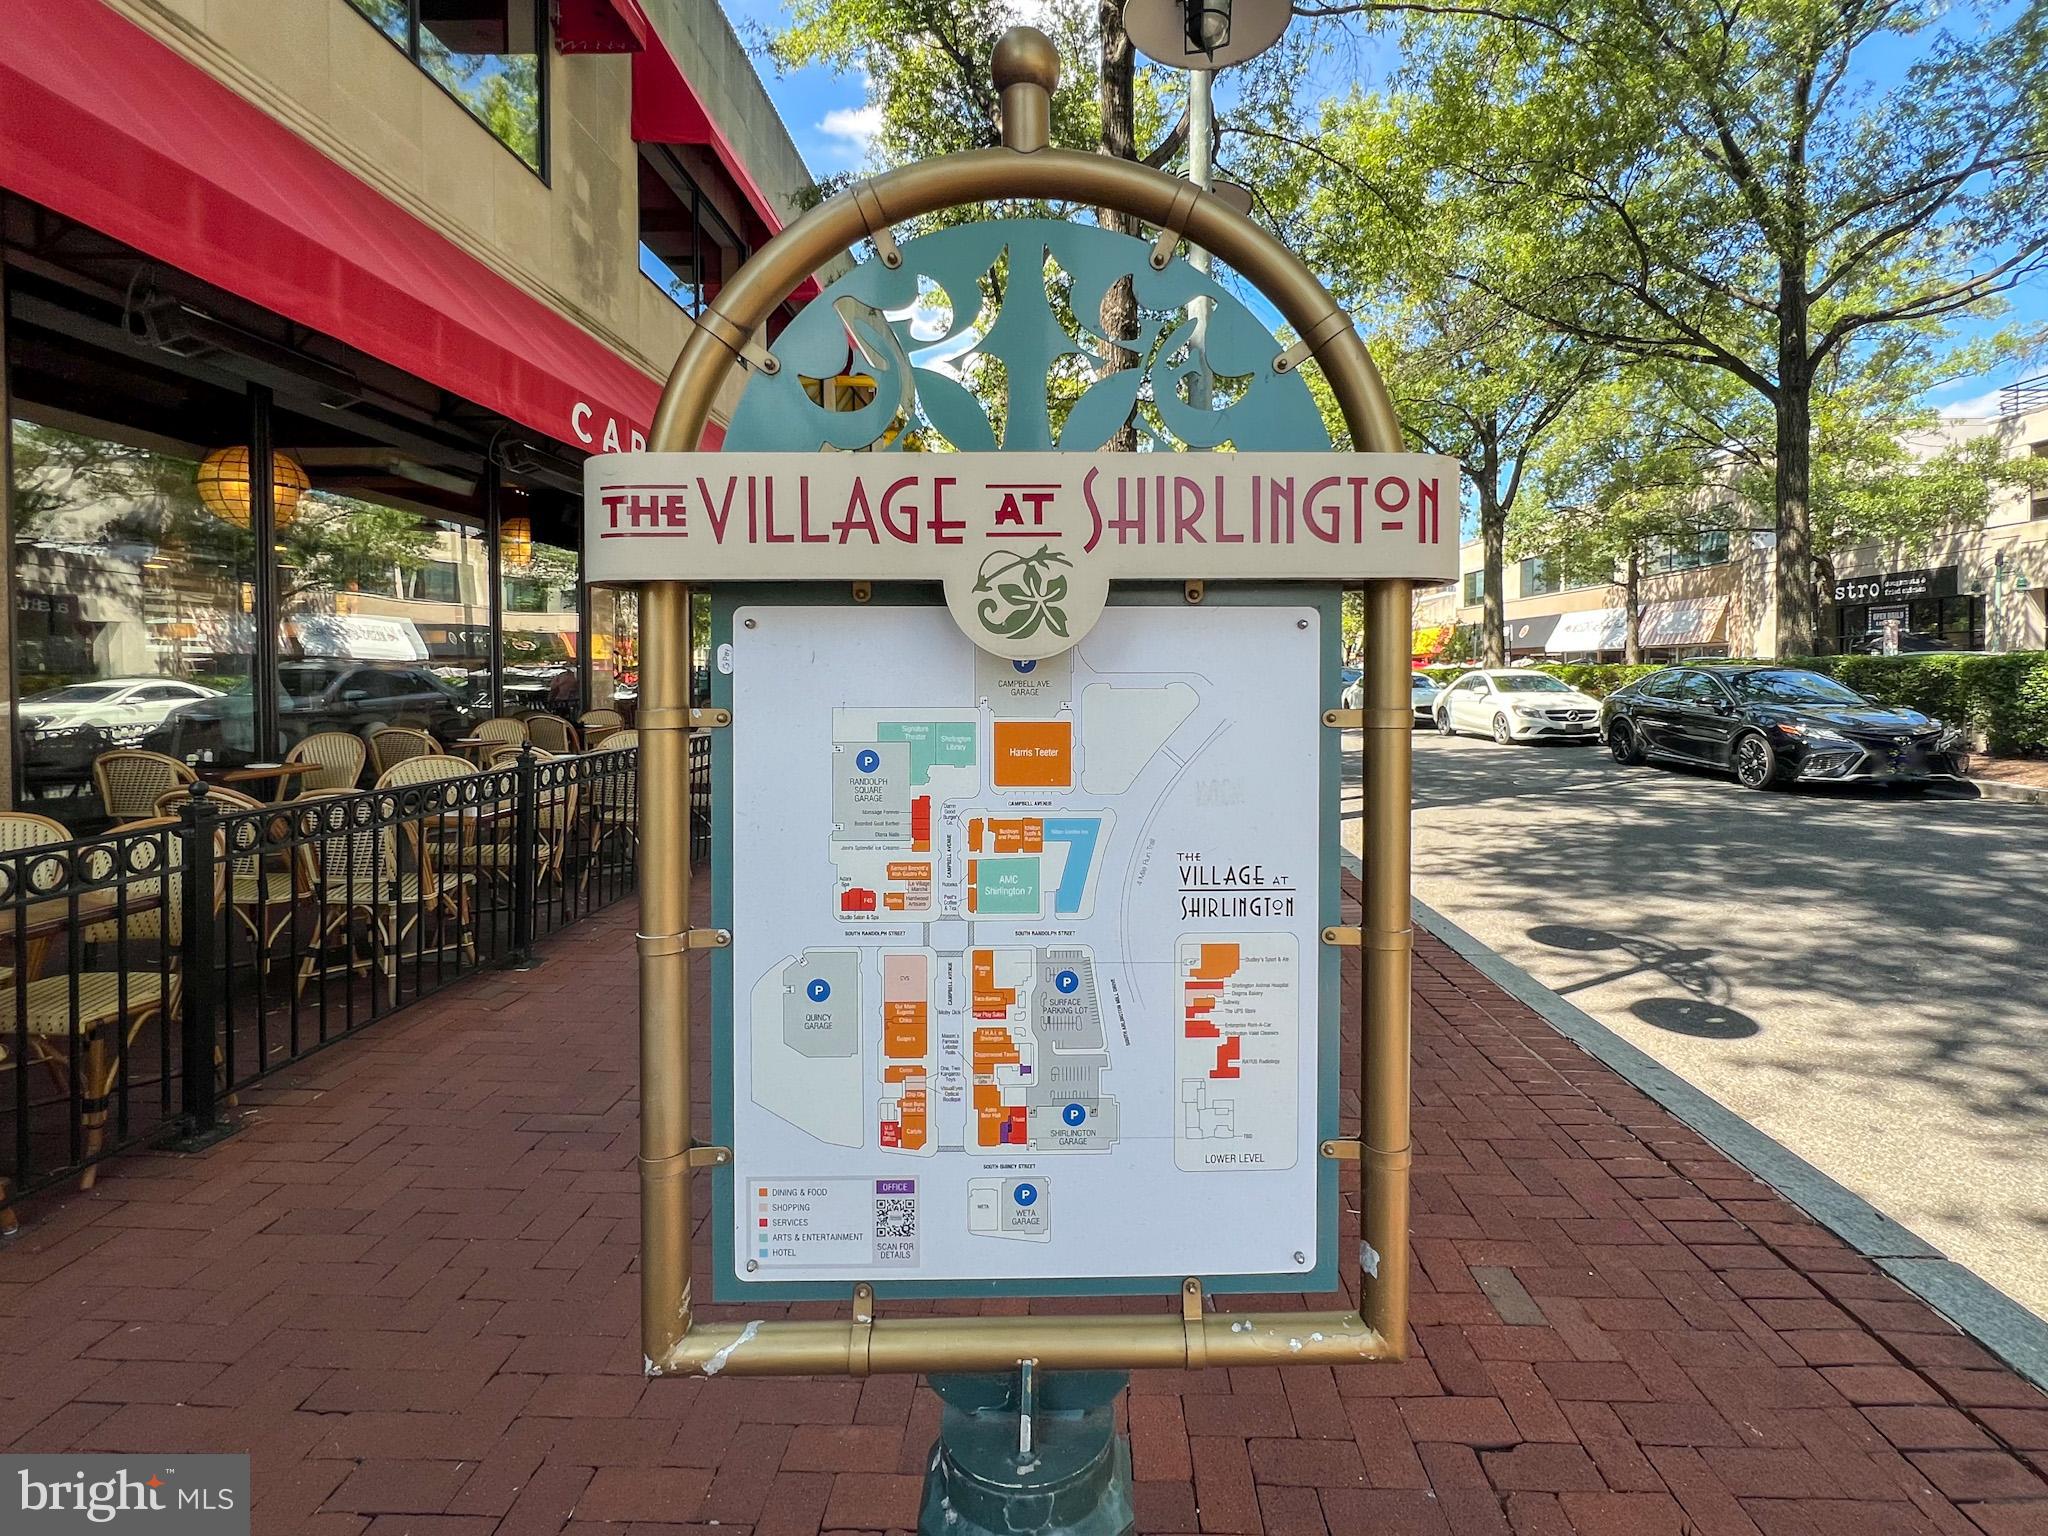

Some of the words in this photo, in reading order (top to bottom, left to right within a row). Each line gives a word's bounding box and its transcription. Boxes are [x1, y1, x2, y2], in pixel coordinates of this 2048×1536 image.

[602, 495, 687, 528] THE
[696, 476, 966, 544] VILLAGE
[995, 493, 1054, 525] AT
[1083, 466, 1439, 554] SHIRLINGTON
[1835, 582, 1880, 601] stro
[1011, 688, 1039, 696] GARAGE
[902, 725, 929, 733] Signature
[947, 744, 966, 752] Library
[1010, 748, 1033, 756] Harris
[1035, 748, 1059, 756] Teeter
[1176, 852, 1201, 862] THE
[1179, 865, 1265, 885] VILLAGE
[1273, 876, 1288, 885] AT
[999, 875, 1018, 884] AMC
[985, 887, 1025, 897] Shirlington
[1028, 887, 1033, 896] 7
[1181, 896, 1294, 921] SHIRLINGTON
[804, 1022, 833, 1030] GARAGE
[1205, 1154, 1236, 1163] LOWER
[1239, 1154, 1265, 1162] LEVEL
[883, 1183, 908, 1191] OFFICE
[772, 1188, 798, 1197] DINING
[800, 1188, 806, 1196] &
[807, 1188, 828, 1196] FOOD
[772, 1204, 810, 1212] SHOPPING
[772, 1219, 809, 1227] SERVICES
[772, 1233, 793, 1241] ARTS
[802, 1233, 864, 1241] ENTERTAINMENT
[877, 1243, 897, 1251] SCAN
[900, 1243, 914, 1251] FOR
[772, 1249, 797, 1257] HOTEL
[880, 1251, 911, 1260] DETAILS
